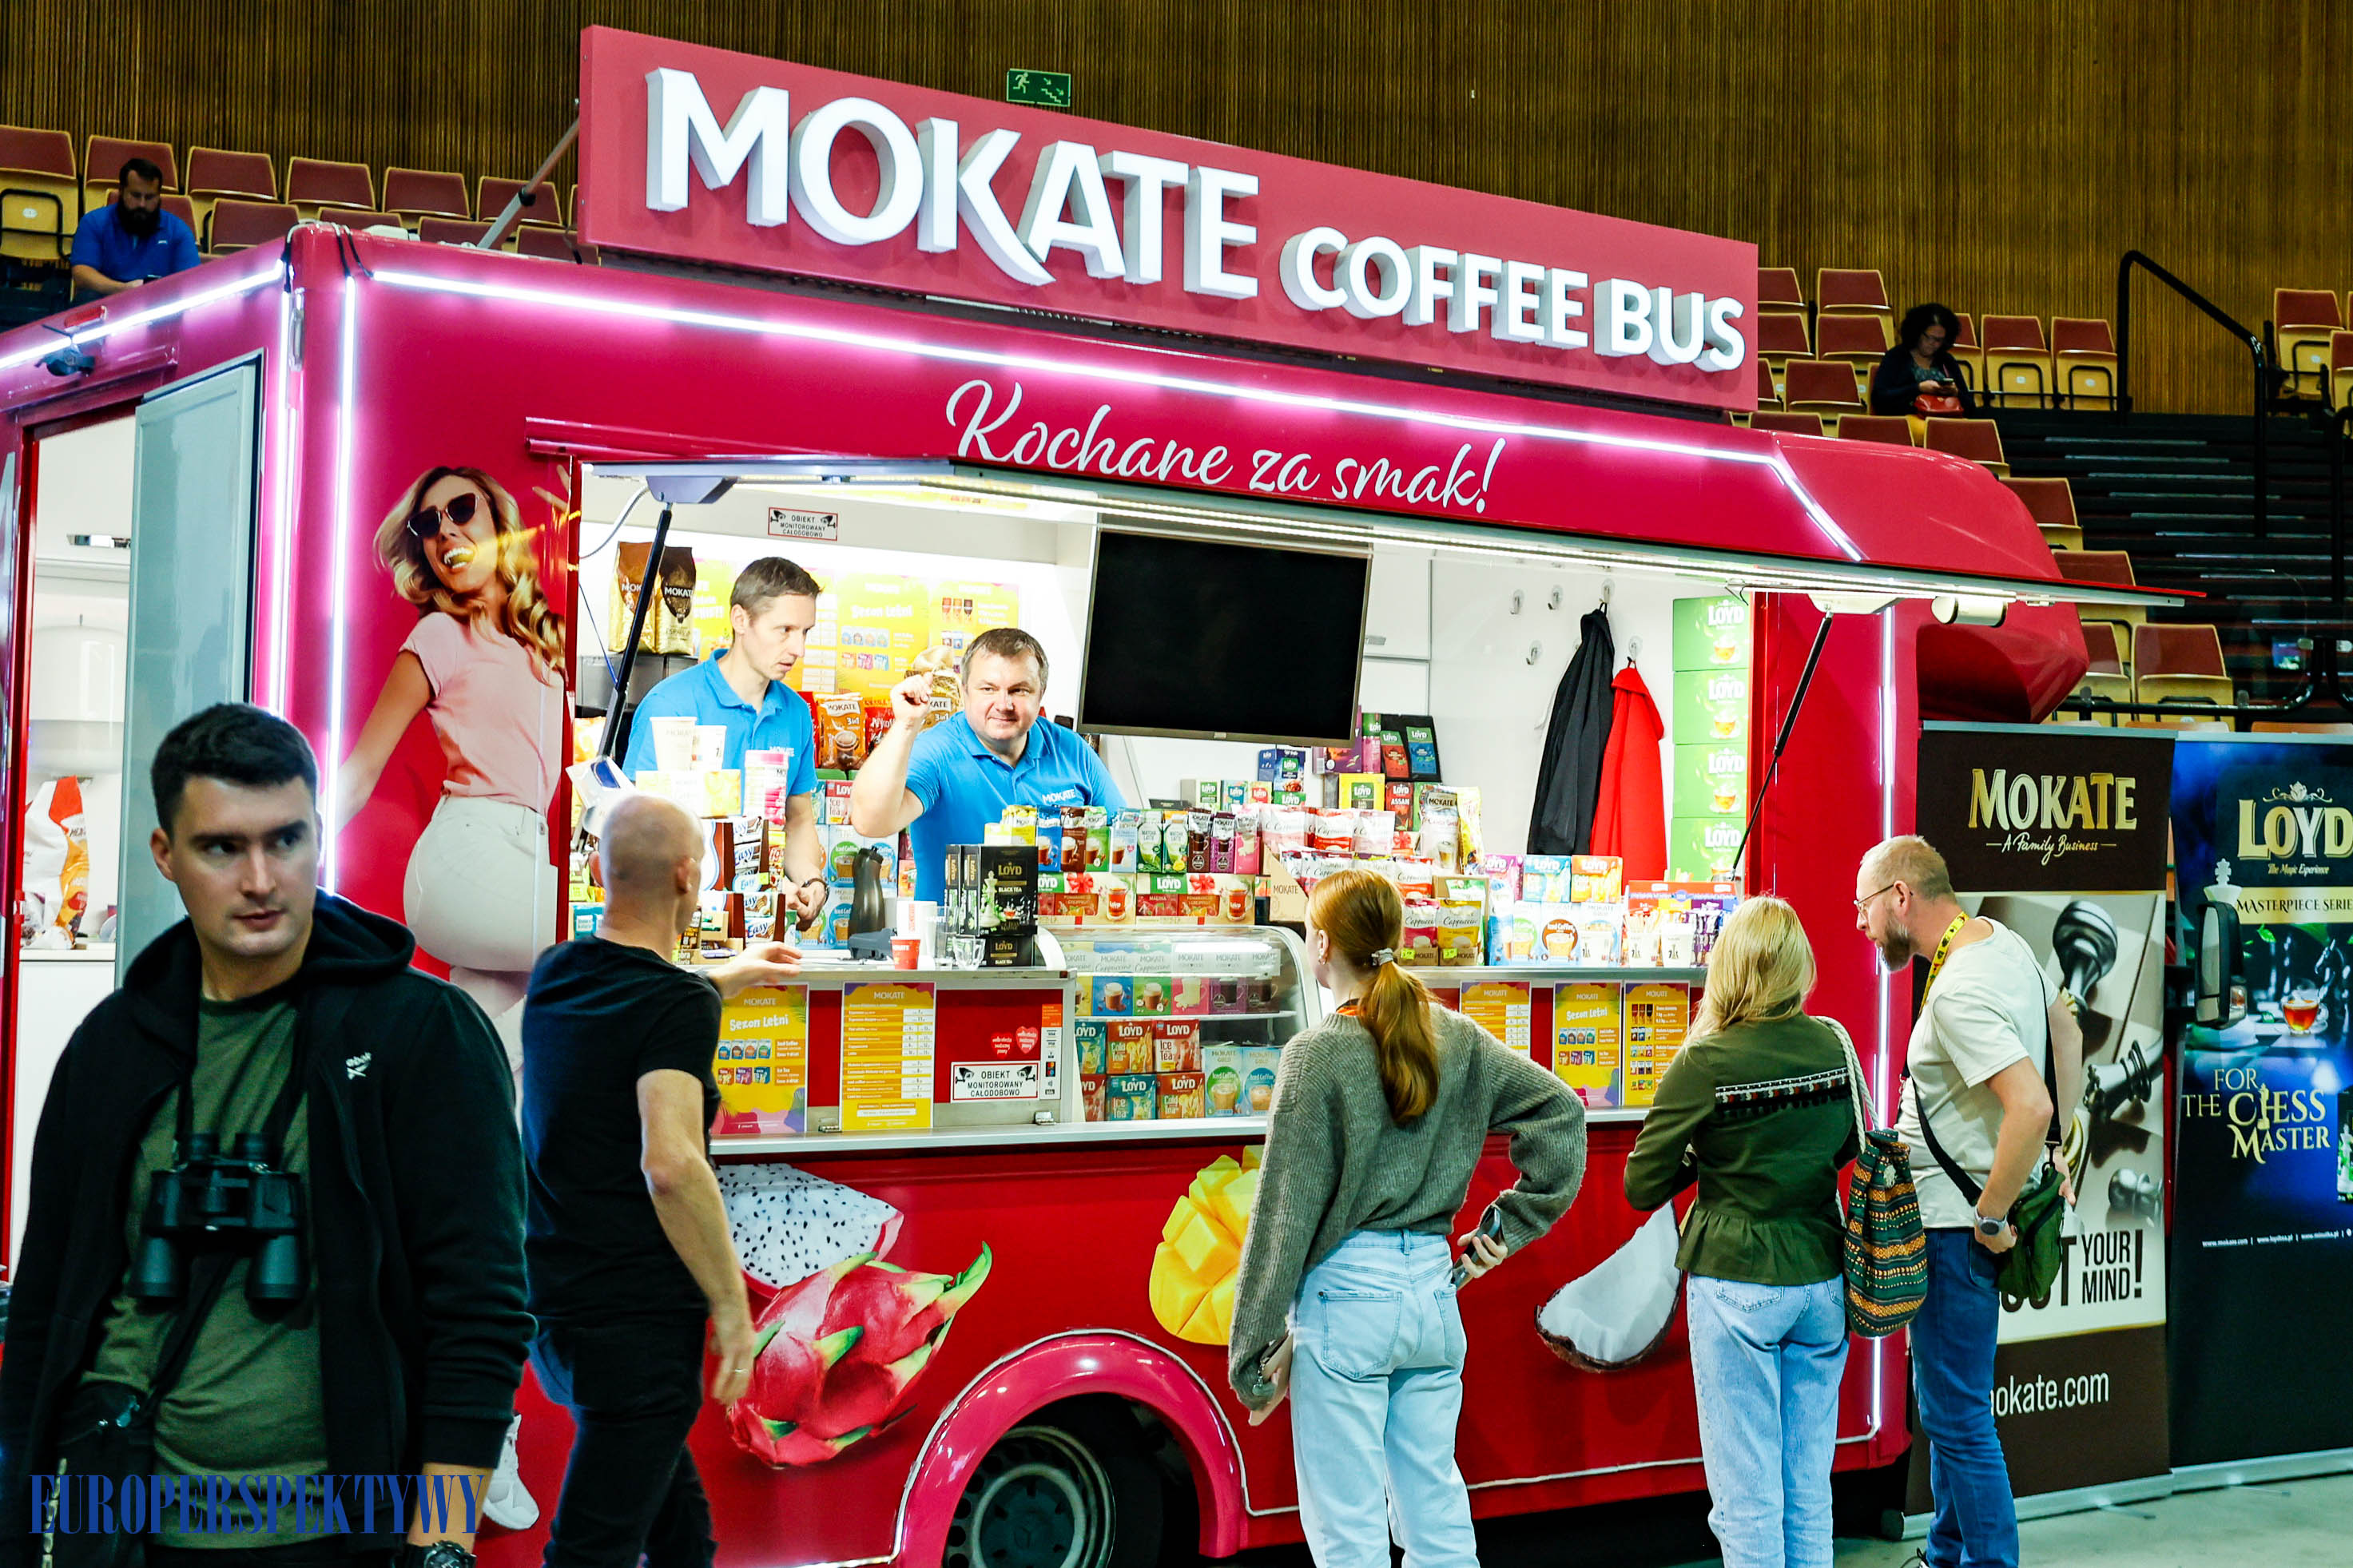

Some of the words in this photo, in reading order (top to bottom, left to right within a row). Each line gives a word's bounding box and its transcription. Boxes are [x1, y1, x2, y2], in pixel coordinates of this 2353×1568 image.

[646, 67, 1259, 300] MOKATE
[1280, 227, 1588, 349] COFFEE
[1594, 278, 1745, 372] BUS
[945, 379, 1233, 485] Kochane
[1250, 449, 1320, 493] za
[1332, 437, 1505, 514] smak!
[622, 583, 642, 592] MOK
[1708, 605, 1745, 626] LOYD
[1708, 679, 1745, 701] LOYD
[1708, 753, 1745, 775] LOYD
[837, 784, 853, 796] LOY
[1042, 789, 1076, 804] MOKATE
[1354, 785, 1371, 796] LOYD
[1393, 784, 1409, 794] LOYD
[1968, 768, 2137, 831] MOKATE
[2237, 799, 2353, 861] LOYD
[1705, 828, 1742, 848] LOYD
[2001, 833, 2012, 853] A
[2013, 832, 2055, 866] Family
[2053, 834, 2099, 857] Business
[999, 865, 1023, 875] LOYD
[1534, 858, 1560, 871] LOYD
[1038, 878, 1058, 888] OYD
[1157, 877, 1182, 890] LOYD
[1274, 884, 1298, 895] MOKATE
[745, 896, 757, 907] asy
[2236, 899, 2321, 915] MASTERPIECE
[748, 922, 768, 938] Easy
[1566, 1010, 1588, 1022] Sezon
[1589, 1007, 1608, 1018] Letni
[729, 1018, 761, 1031] Sezon
[763, 1014, 789, 1027] Letni
[1167, 1024, 1190, 1036] LOYD
[1119, 1025, 1143, 1037] LOYD
[1160, 1040, 1172, 1050] Ice
[1160, 1050, 1173, 1061] Tea
[981, 1070, 1010, 1079] OBIEKT
[2214, 1068, 2260, 1090] FOR
[1081, 1081, 1095, 1091] YD
[1122, 1081, 1147, 1093] LOYD
[1172, 1078, 1196, 1090] LOYD
[2181, 1094, 2222, 1117] THE
[2228, 1084, 2327, 1129] CHESS
[2227, 1124, 2331, 1165] MASTER
[2081, 1229, 2131, 1266] YOUR
